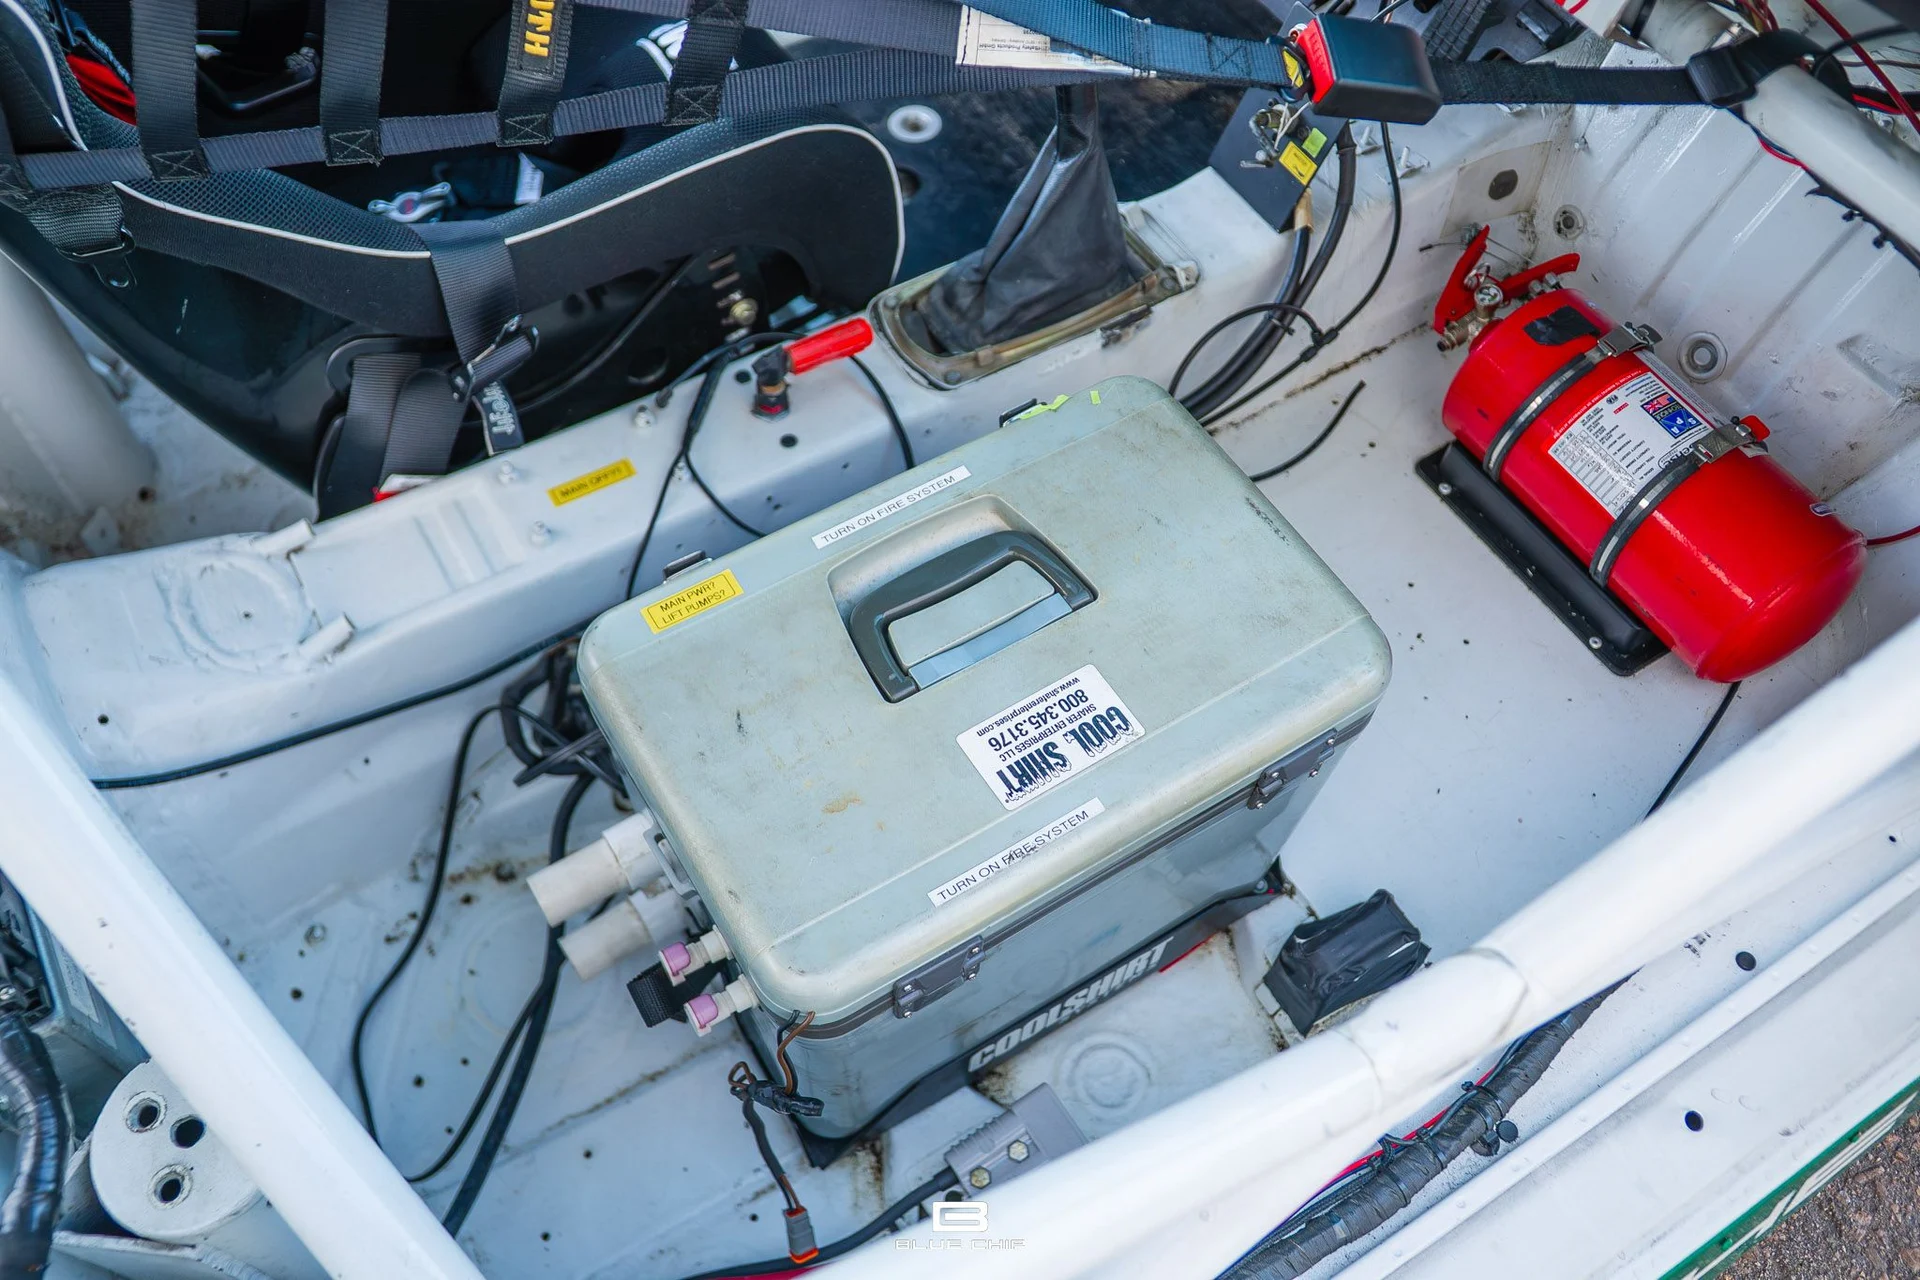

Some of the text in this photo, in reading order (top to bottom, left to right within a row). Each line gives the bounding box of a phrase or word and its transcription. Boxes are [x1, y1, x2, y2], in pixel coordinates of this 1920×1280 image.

[821, 475, 955, 543] TURN ON FIRE SYSTEM
[659, 580, 715, 612] MAIN PWR?
[661, 588, 724, 623] LIFT PUMPS?
[976, 676, 1080, 737] www.shaferenterprises.com
[987, 688, 1088, 752] 800.345.3176
[998, 703, 1096, 761] SHAFER ENTERPRISES LLC
[995, 705, 1134, 800] COOL SHIRT
[937, 810, 1089, 899] TURN ON FIRE SYSTEM
[968, 936, 1174, 1072] COOLSHIRT
